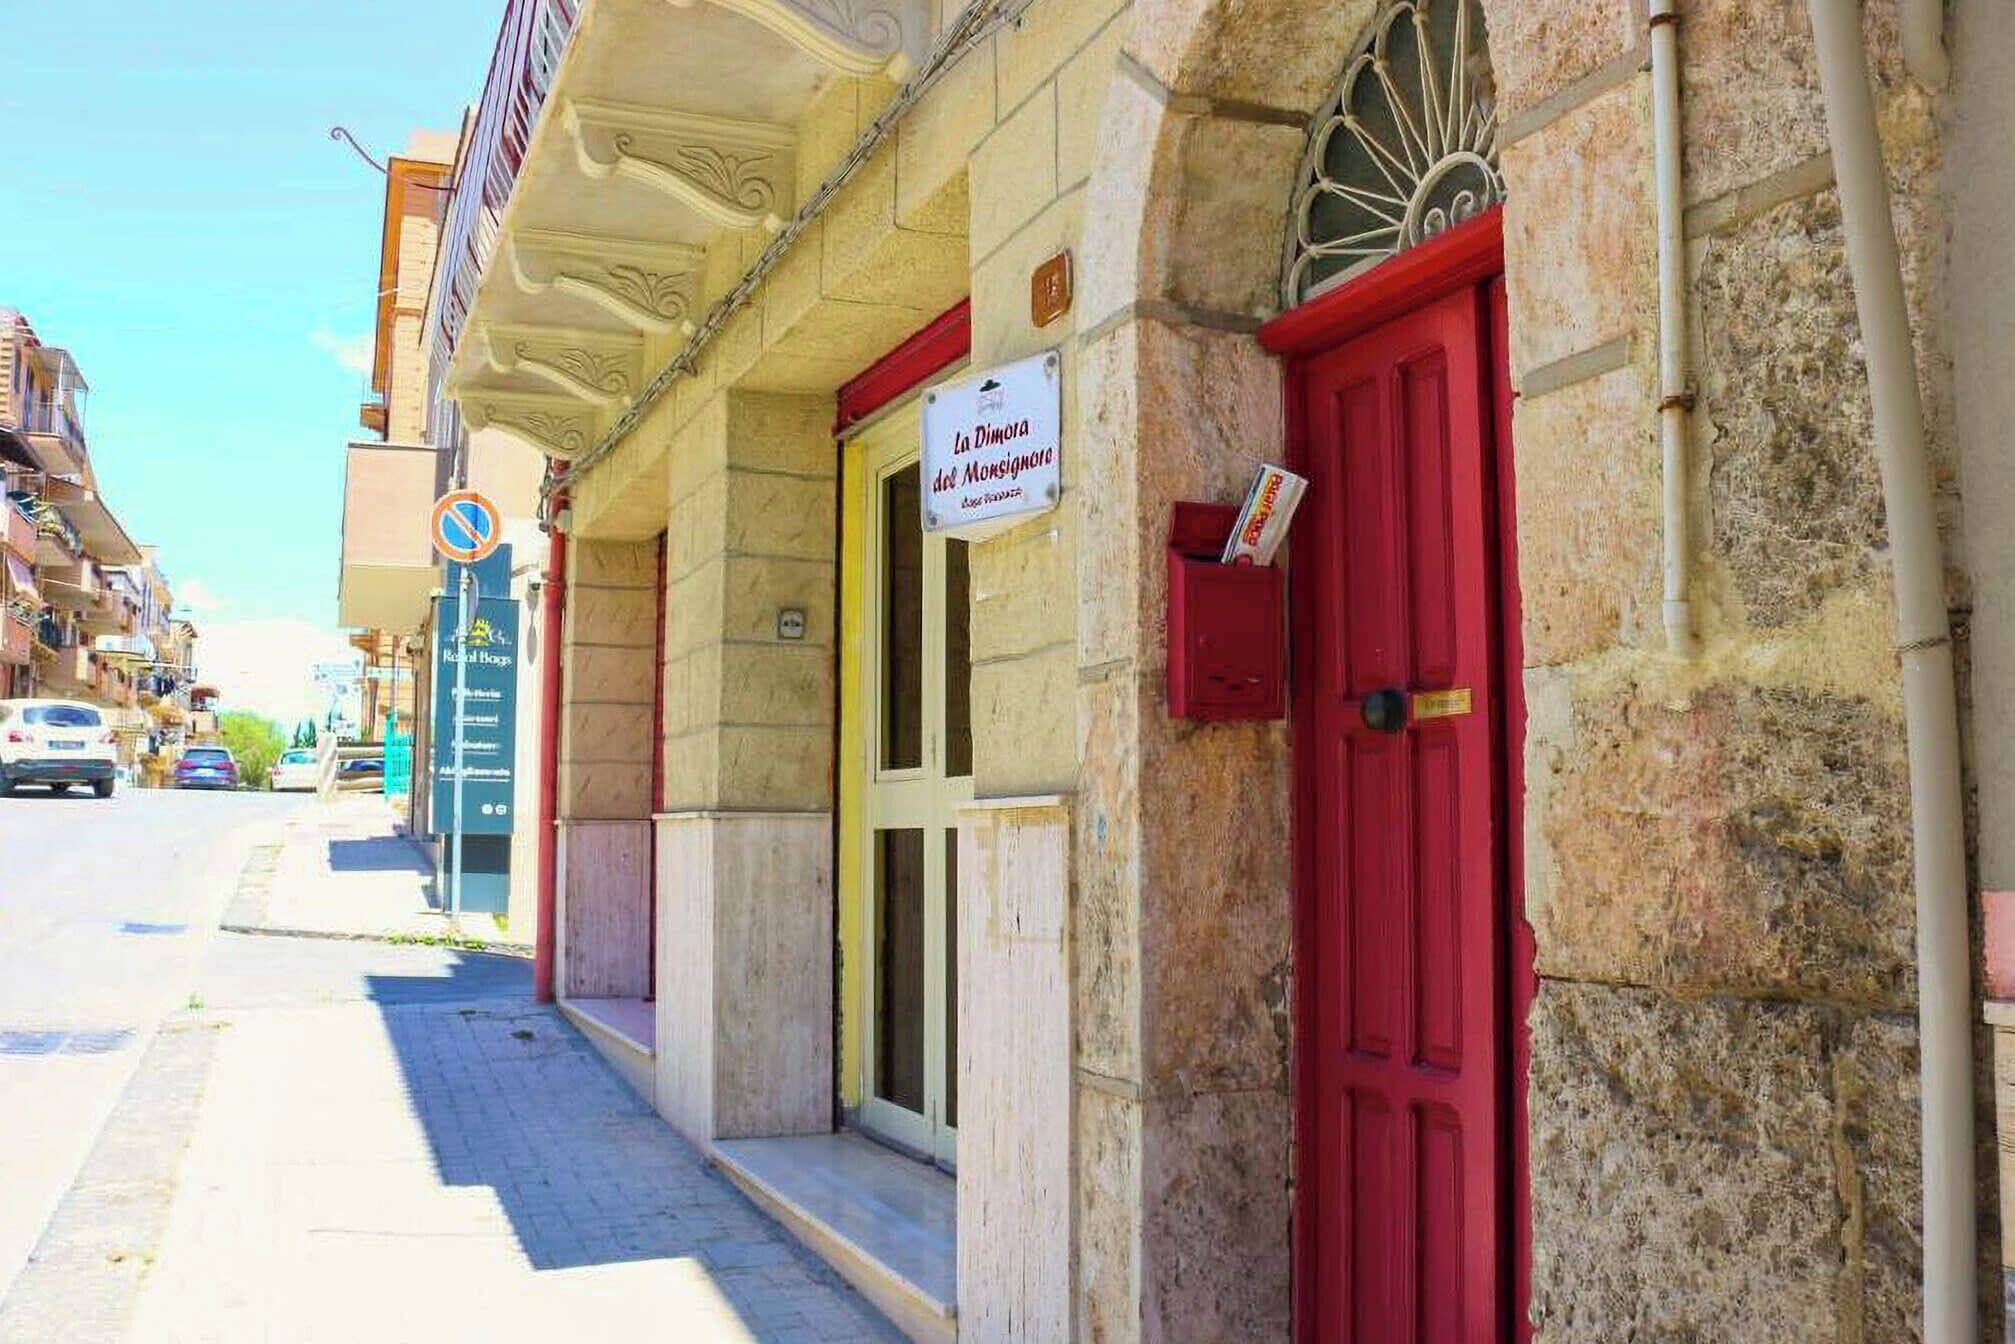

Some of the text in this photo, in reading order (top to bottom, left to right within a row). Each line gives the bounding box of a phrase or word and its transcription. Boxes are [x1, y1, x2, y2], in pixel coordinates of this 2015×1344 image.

[954, 419, 1029, 455] La Dimora
[932, 446, 1053, 494] del Monsignore
